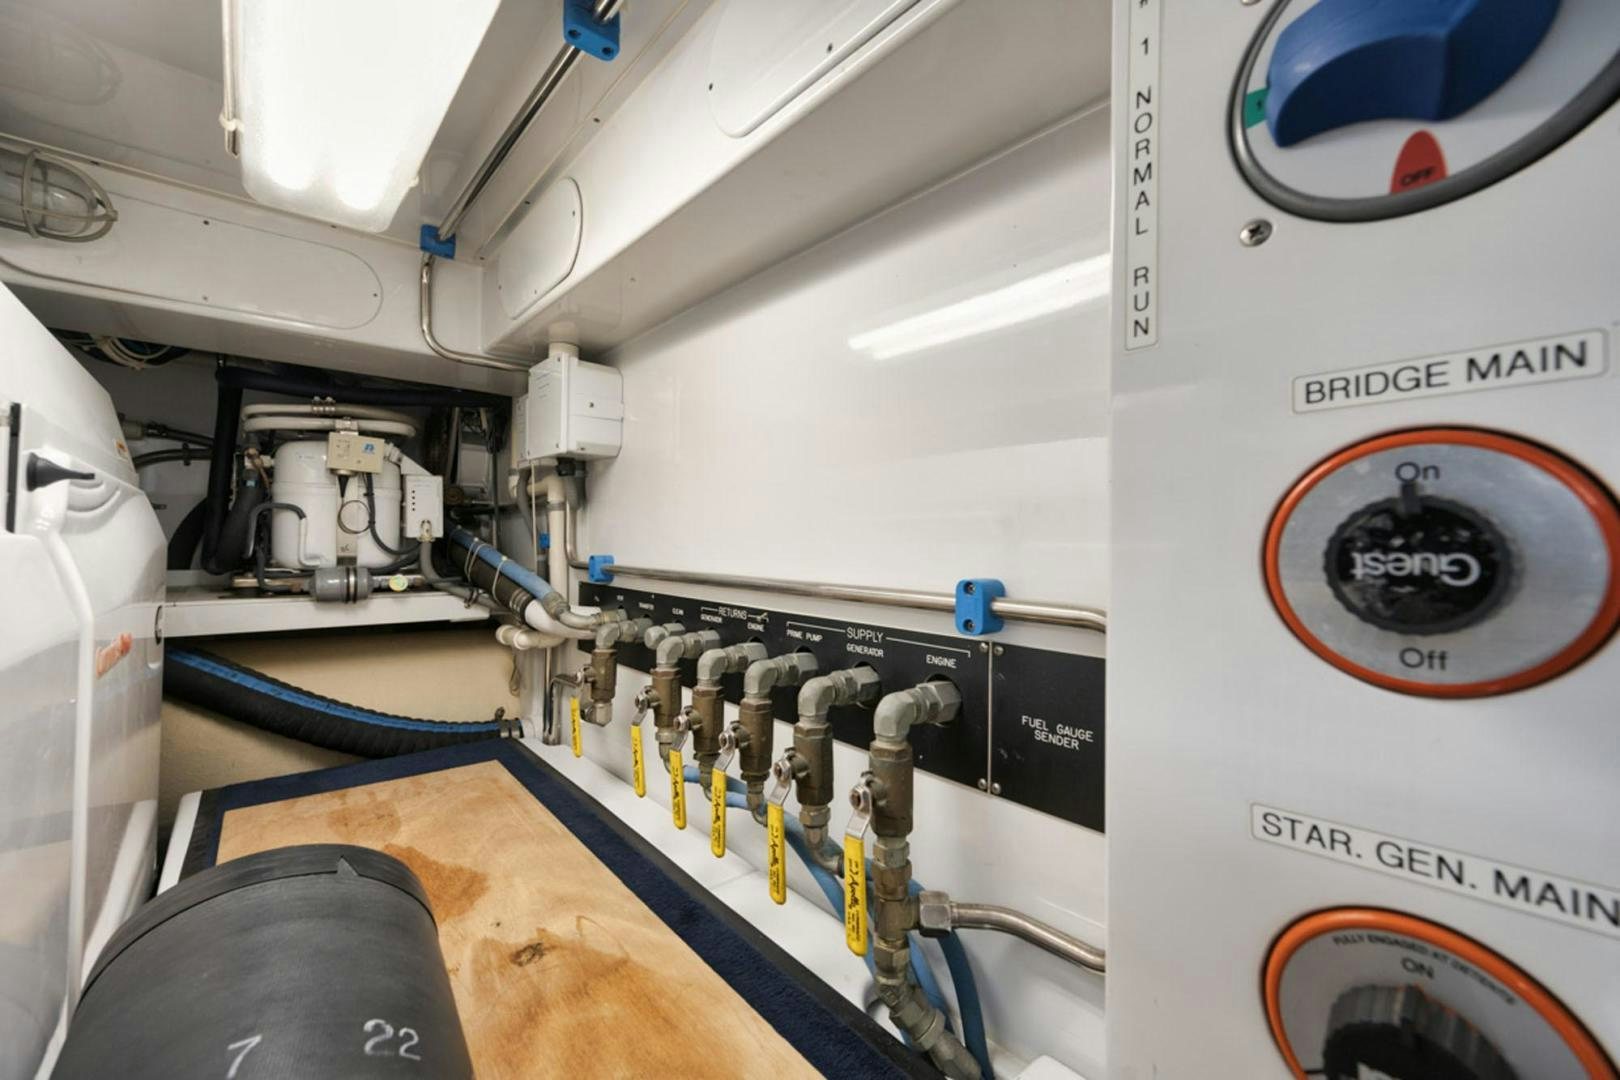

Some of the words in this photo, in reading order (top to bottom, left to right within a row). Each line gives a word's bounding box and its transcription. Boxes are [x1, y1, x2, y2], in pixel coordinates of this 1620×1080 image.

[1133, 86, 1153, 236] NORMAL
[1400, 166, 1437, 187] OFF
[1132, 266, 1151, 338] RUN
[1304, 360, 1450, 405] BRIDGE
[1466, 340, 1588, 383] MAIN
[1395, 461, 1441, 483] On
[1352, 552, 1481, 588] Guest
[718, 605, 747, 620] RETURNS
[806, 632, 823, 642] PUMP
[846, 626, 884, 644] SUPPLY
[846, 643, 884, 658] GENERATOR
[926, 654, 957, 669] ENGINE
[1398, 647, 1448, 670] Off
[1021, 714, 1049, 732] FUEL
[1056, 723, 1094, 742] GAUGE
[1034, 729, 1080, 750] SENDER
[1260, 811, 1363, 859] STAR.
[1375, 840, 1477, 890] GEN.
[1493, 868, 1620, 928] MAIN
[1401, 957, 1435, 980] ON
